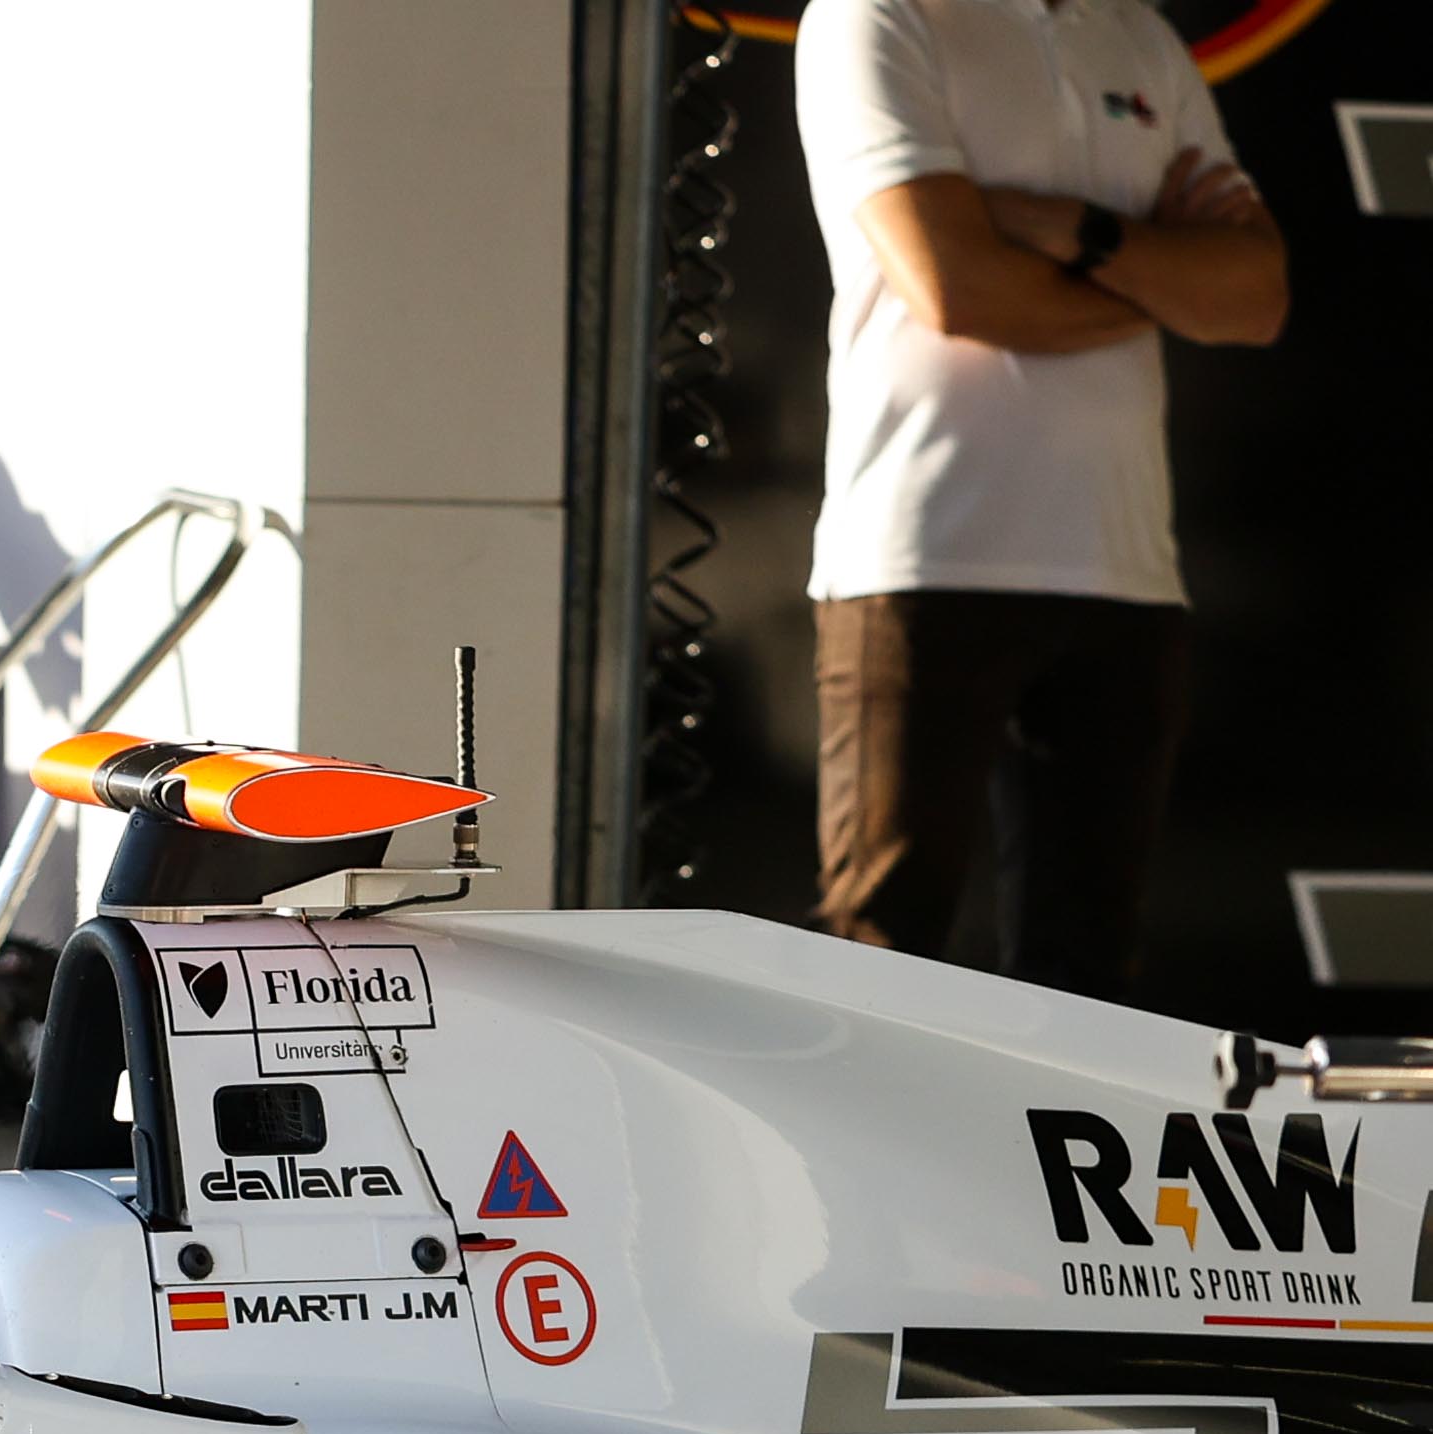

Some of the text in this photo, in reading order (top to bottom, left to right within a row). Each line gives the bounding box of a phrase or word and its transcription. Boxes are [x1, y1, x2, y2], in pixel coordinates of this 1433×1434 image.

[262, 966, 416, 1005] Florida
[200, 1156, 403, 1201] dallara
[1026, 1108, 1362, 1254] RAW
[1062, 1262, 1362, 1305] ORGANIC SPORT DRINK
[234, 1291, 459, 1324] MARTI J.M
[523, 1274, 570, 1343] E
